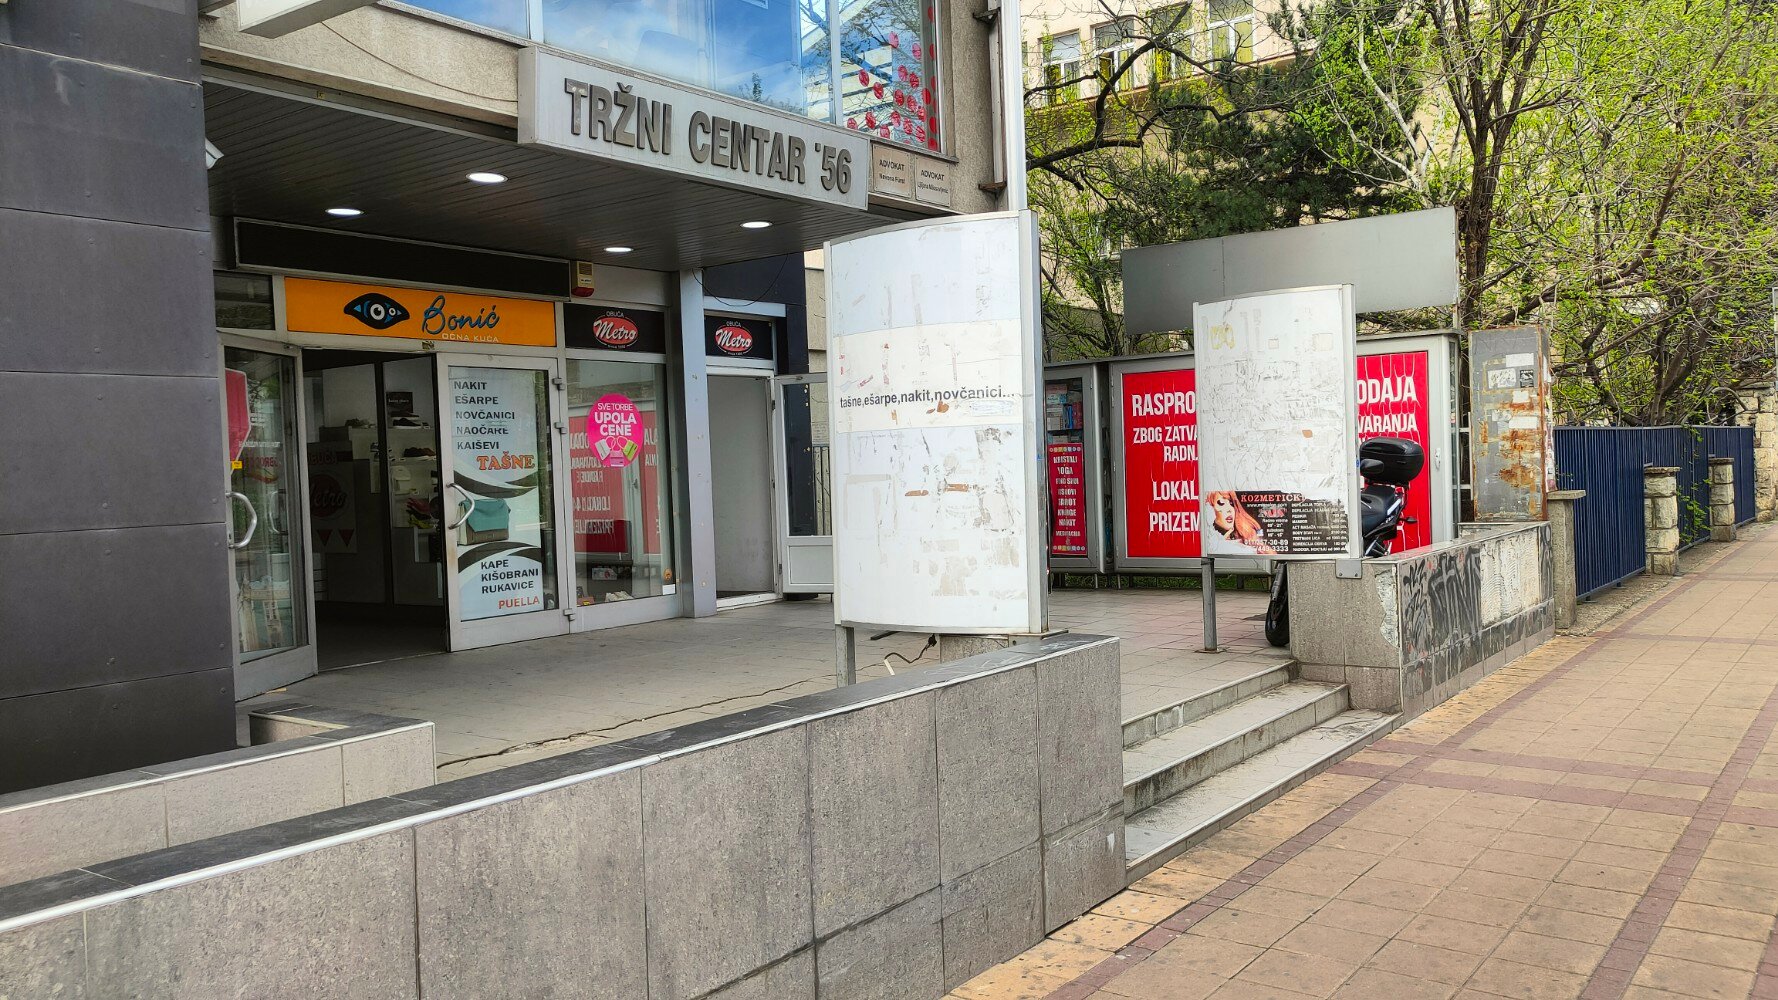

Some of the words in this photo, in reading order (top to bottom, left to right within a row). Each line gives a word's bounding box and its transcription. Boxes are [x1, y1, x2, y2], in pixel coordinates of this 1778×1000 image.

[565, 78, 672, 155] TRŽNI
[689, 110, 806, 184] CENTAR
[879, 159, 905, 171] ADVOKAT
[921, 170, 945, 181] ADVOKAT
[422, 295, 500, 335] Bonić
[593, 320, 637, 340] Metro
[715, 329, 752, 348] Metro
[454, 381, 487, 390] NAKIT
[455, 394, 499, 405] EŠARPE
[597, 403, 611, 411] SVE
[612, 403, 634, 411] TORBE
[455, 409, 515, 420] NOVČANICI
[456, 424, 509, 435] NAOČARE
[600, 424, 632, 436] CENE
[1133, 427, 1163, 443] ZBOG
[457, 440, 500, 450] KAIŠEVI
[476, 451, 536, 470] TAŠNE
[1153, 480, 1199, 500] LOKAL
[481, 559, 509, 570] KAPE
[481, 568, 539, 582] KIŠOBRANI
[481, 580, 534, 594] RUKAVICE
[498, 595, 540, 609] PUELLA
